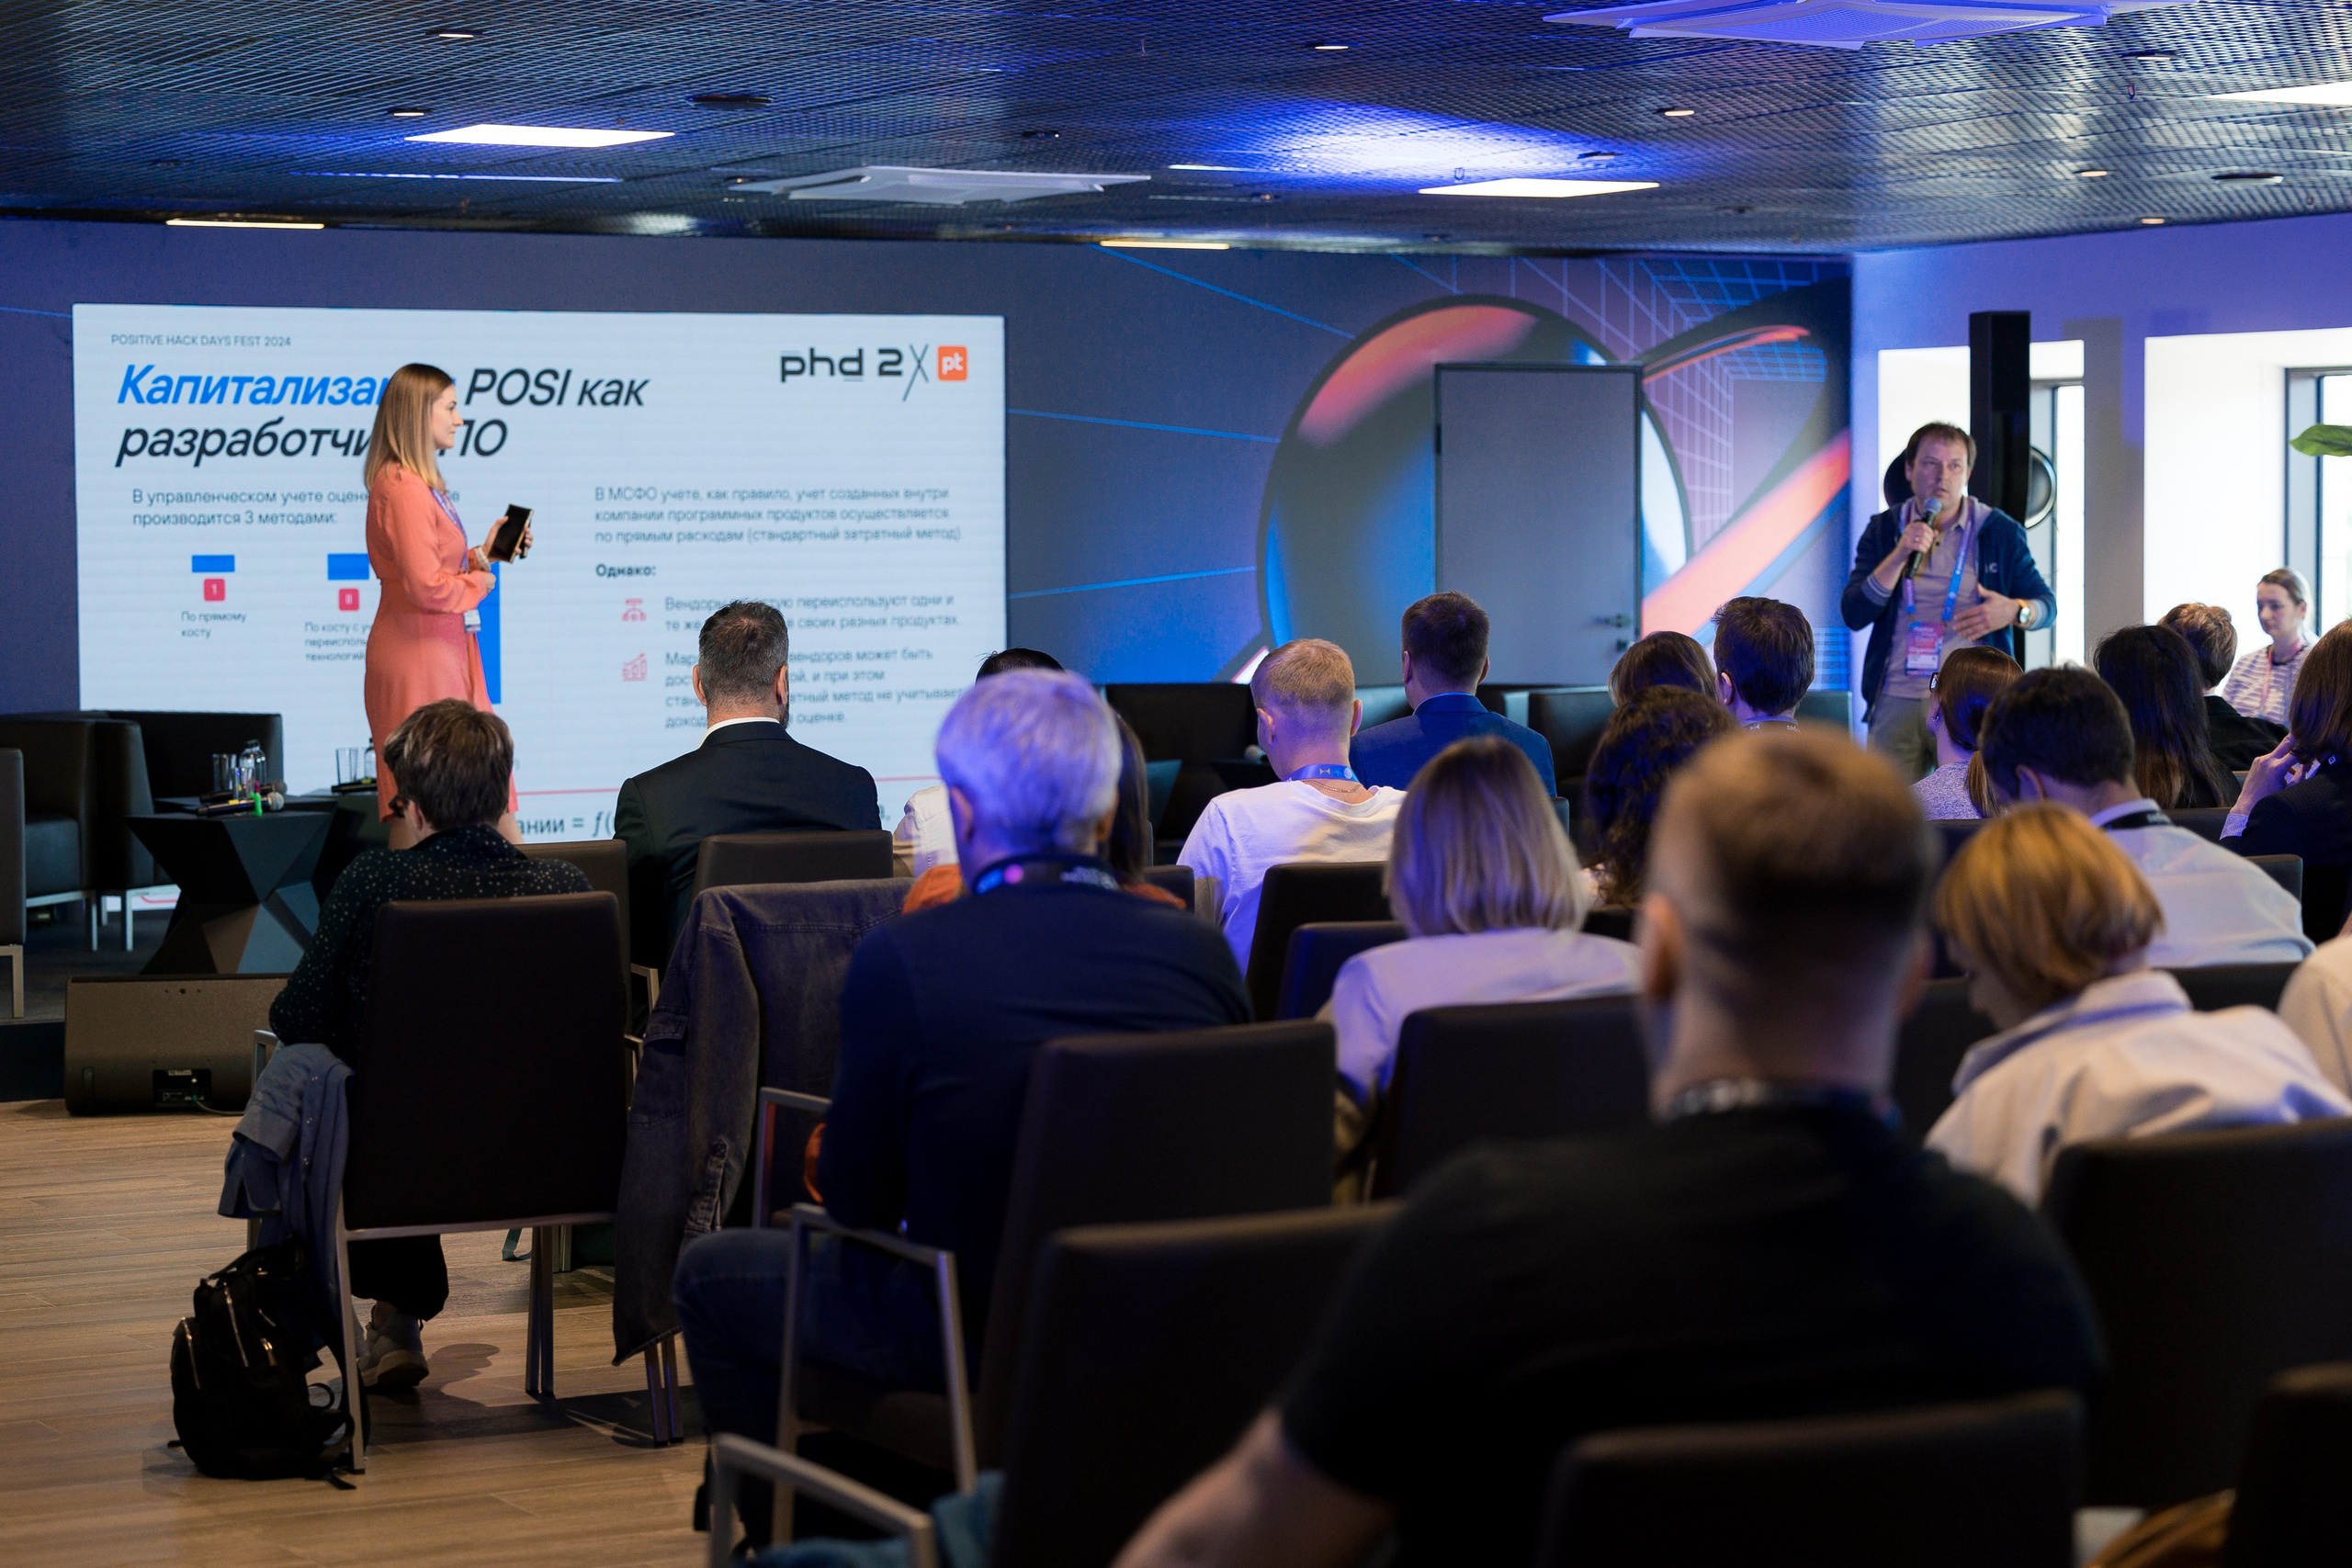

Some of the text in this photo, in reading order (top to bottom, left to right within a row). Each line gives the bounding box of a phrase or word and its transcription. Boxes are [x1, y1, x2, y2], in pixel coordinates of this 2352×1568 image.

[111, 333, 291, 347] POSITIVE HACK DAYS FEST 2024
[780, 347, 865, 383] phd
[941, 351, 964, 376] pt
[117, 364, 650, 407] Капитализа POSI как
[115, 416, 371, 468] разработчи
[132, 488, 144, 504] В
[147, 490, 277, 506] управленческом
[280, 491, 323, 506] учете
[594, 486, 605, 502] В
[608, 486, 659, 502] МСФО
[707, 490, 727, 500] как
[796, 490, 825, 503] учет
[829, 489, 899, 501] созданных
[903, 489, 949, 502] внутри
[132, 510, 338, 529] производится 3 методами:
[594, 508, 949, 524] компании программных продуктов осуществляется
[594, 531, 613, 543] по
[616, 531, 673, 545] прямым
[677, 530, 744, 544] расходам
[747, 526, 840, 545] (стандартный
[842, 525, 912, 542] затратный
[595, 562, 657, 579] Однако:
[797, 595, 908, 611] переиспользуют
[910, 595, 943, 607] одни
[945, 595, 955, 605] и
[181, 611, 247, 625] По прямому
[797, 618, 836, 629] своих
[840, 616, 888, 632] разных
[181, 627, 211, 639] косту
[304, 621, 320, 632] По
[322, 623, 350, 635] косту
[855, 649, 898, 661] может
[901, 646, 933, 660] быть
[823, 671, 849, 684] при
[852, 670, 886, 682] этом
[832, 690, 874, 704] метод
[876, 690, 892, 700] не
